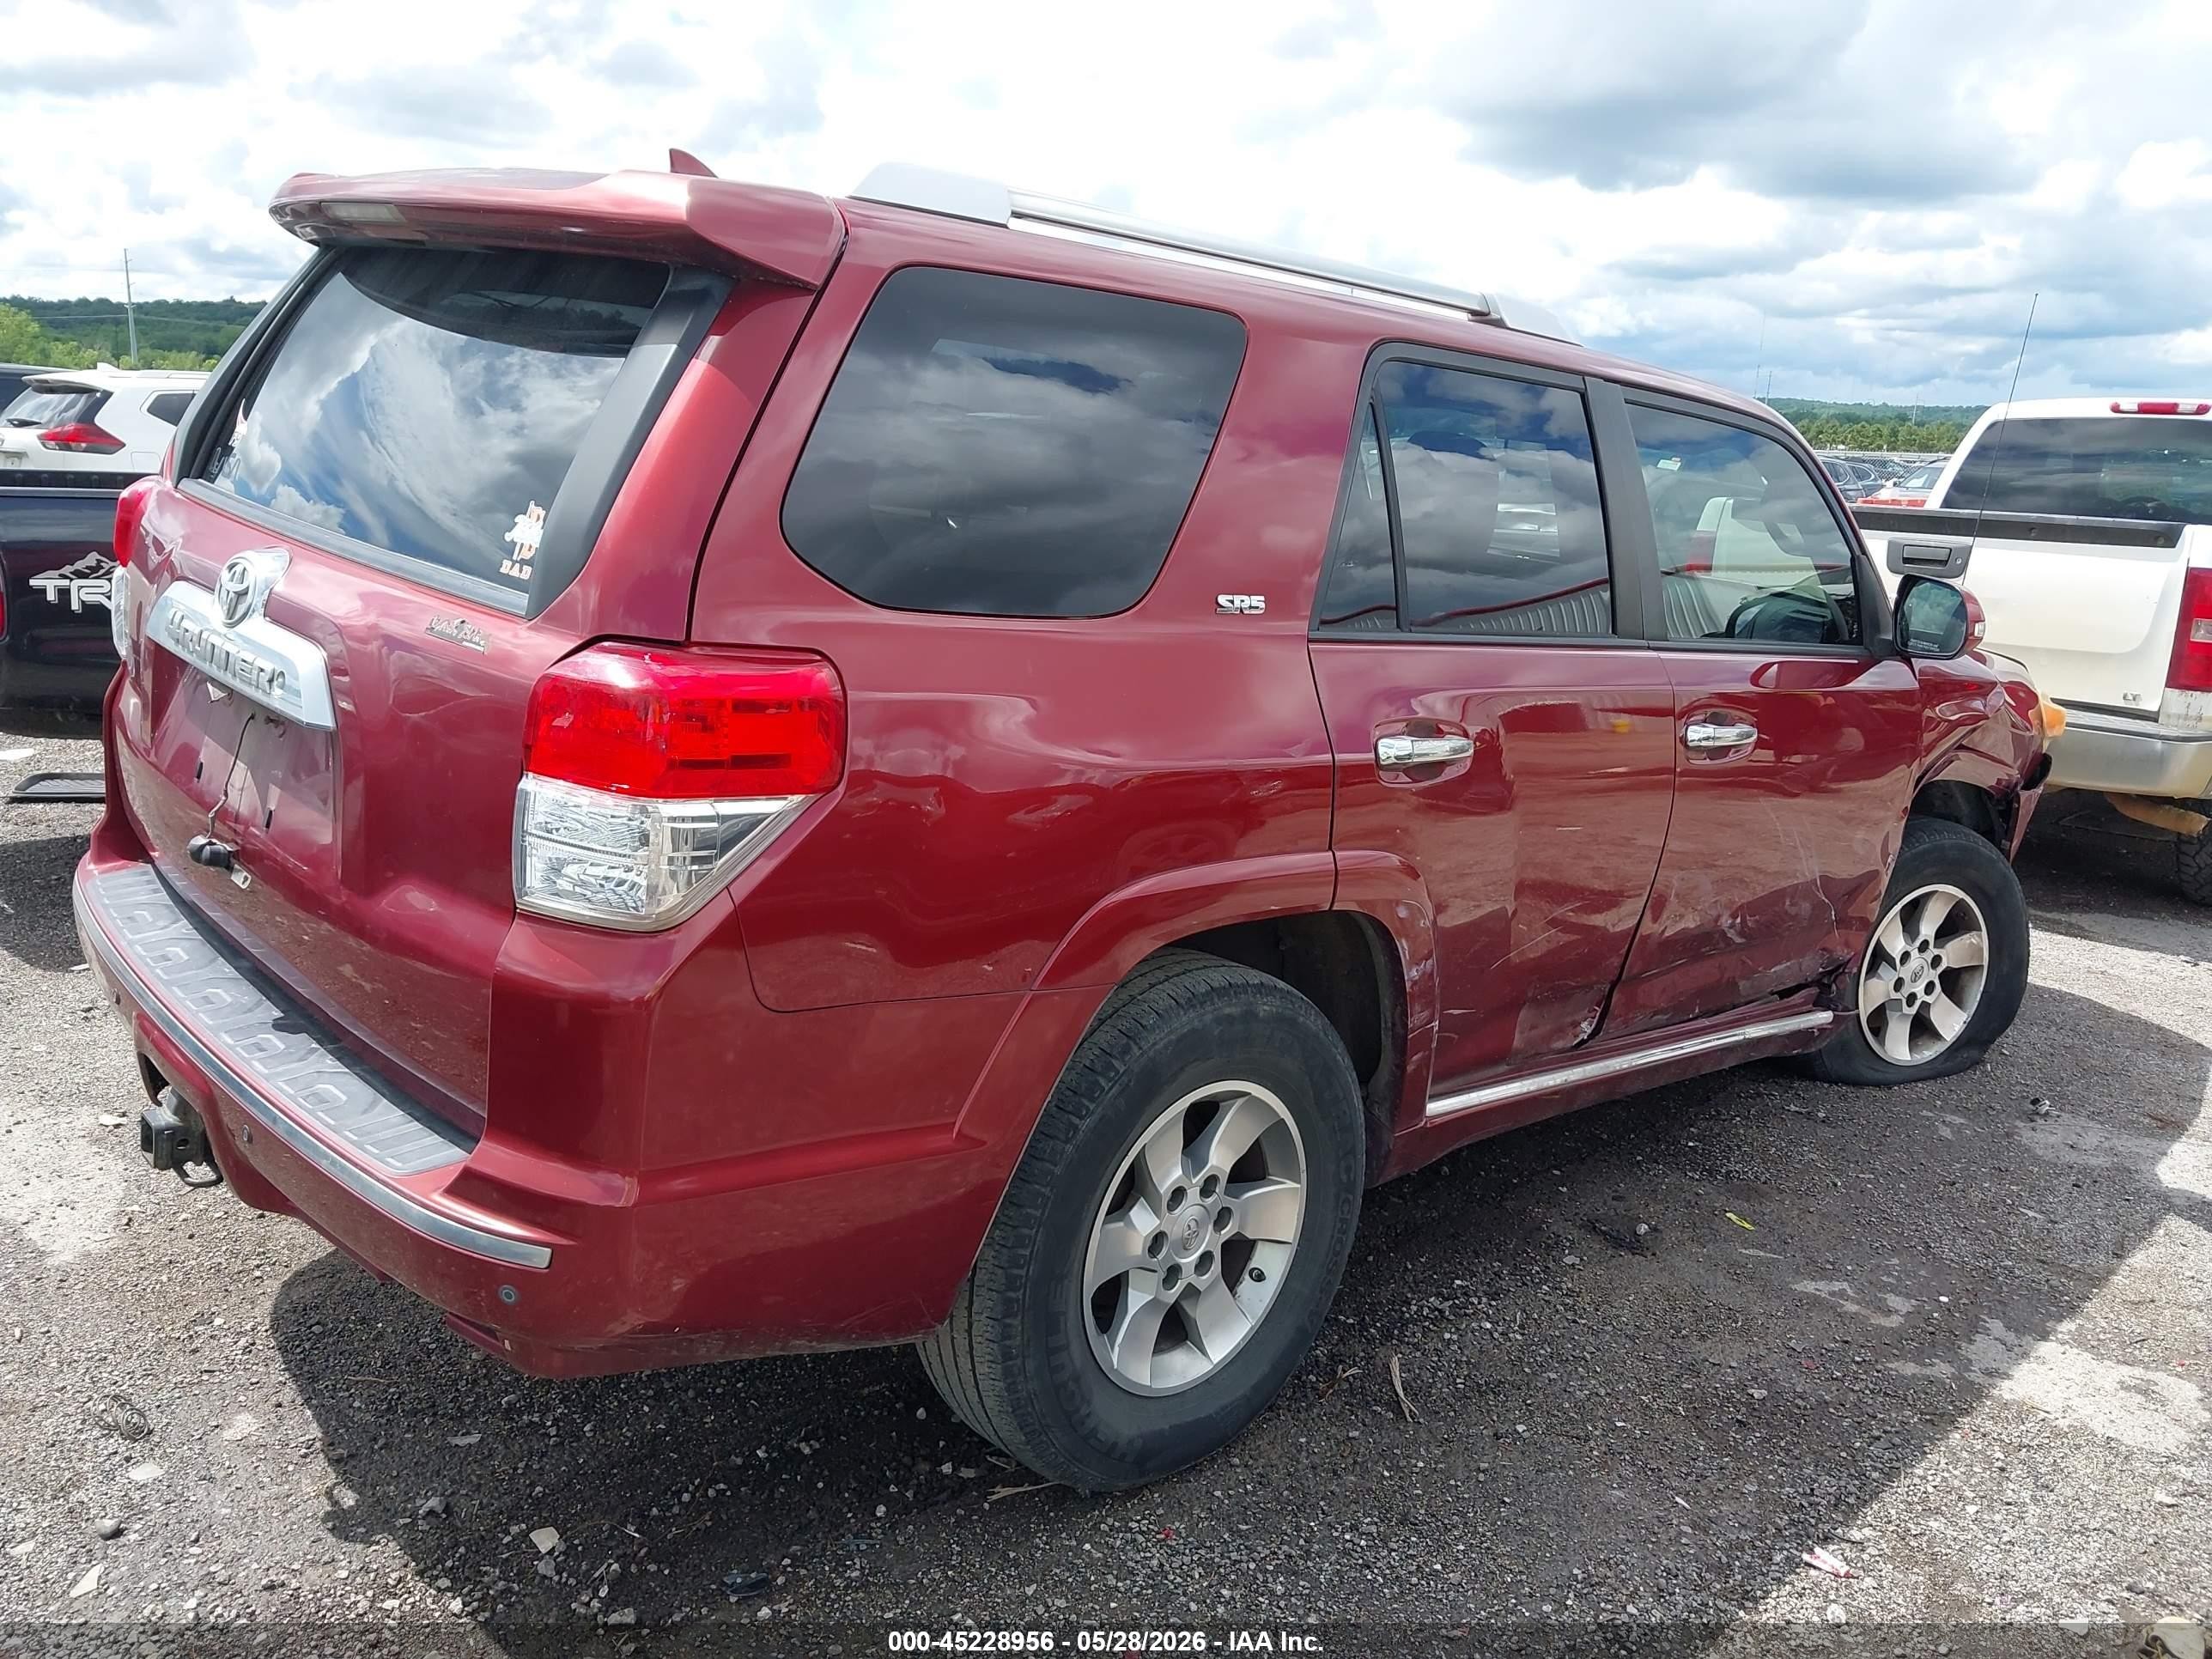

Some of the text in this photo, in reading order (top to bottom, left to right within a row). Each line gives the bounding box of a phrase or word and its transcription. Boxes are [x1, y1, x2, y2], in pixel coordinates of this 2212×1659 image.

[499, 559, 532, 580] DAD
[28, 578, 115, 613] TR
[1216, 593, 1267, 615] SR5
[165, 609, 276, 694] 4RUNNER
[1044, 1278, 1145, 1464] HERCULE
